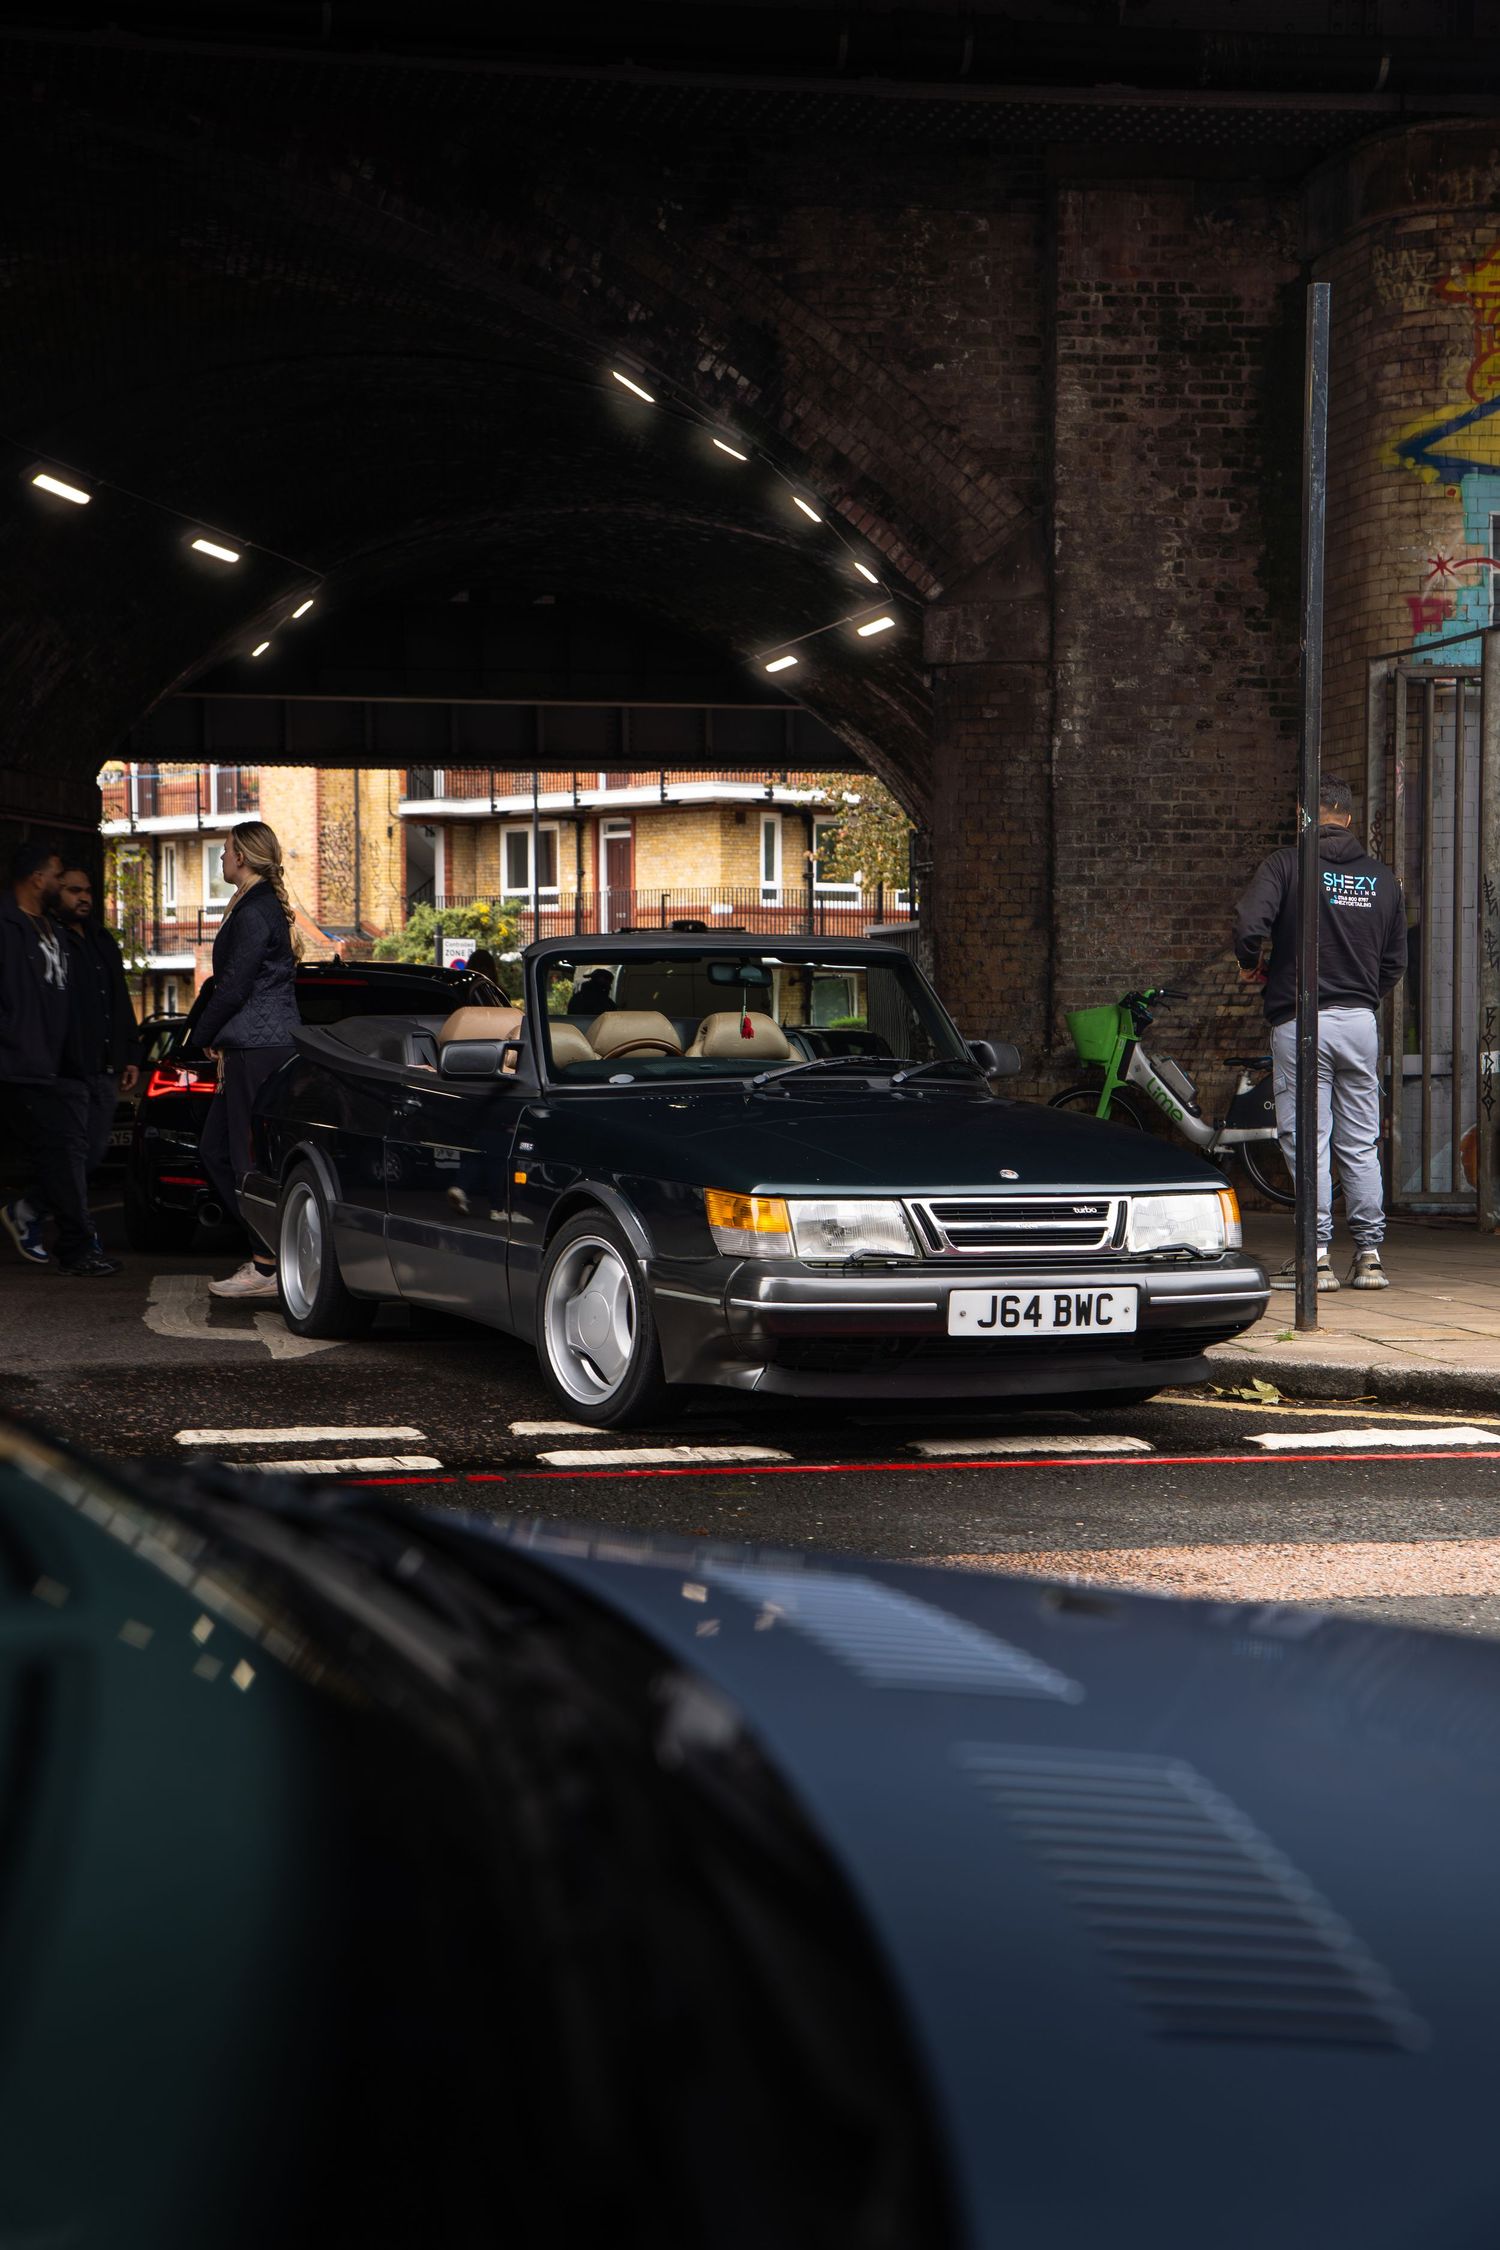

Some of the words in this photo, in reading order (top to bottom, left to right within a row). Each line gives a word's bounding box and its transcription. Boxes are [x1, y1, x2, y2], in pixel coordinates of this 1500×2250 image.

[1323, 872, 1377, 891] SHEZY
[1325, 886, 1377, 896] DETAILING
[445, 949, 465, 957] ZONE
[1146, 1077, 1184, 1121] Lime
[1073, 1205, 1098, 1214] turbo
[977, 1294, 1042, 1328] J64
[1053, 1292, 1114, 1327] BWC
